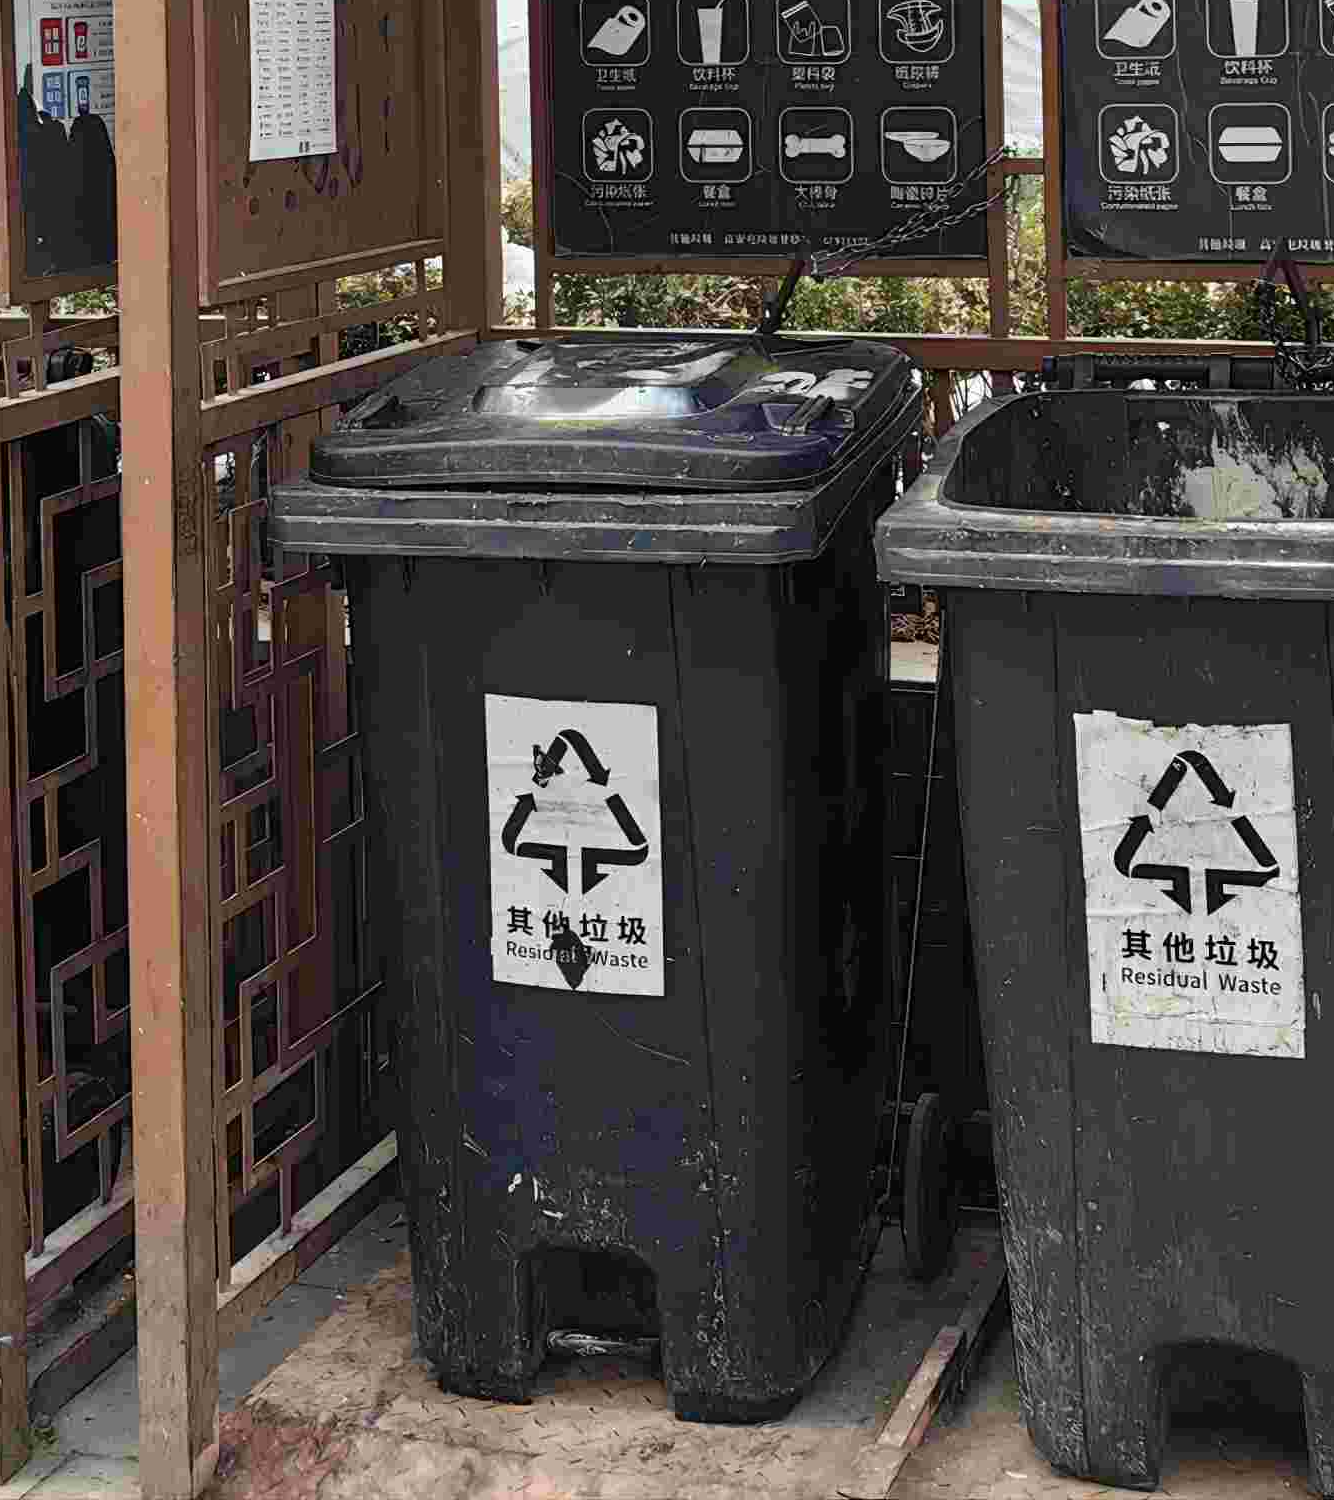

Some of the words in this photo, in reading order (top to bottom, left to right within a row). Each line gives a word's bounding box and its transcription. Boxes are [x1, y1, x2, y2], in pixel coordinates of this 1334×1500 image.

[507, 905, 648, 946] 其他垃圾
[591, 948, 650, 969] Waste
[1121, 928, 1280, 971] 其他垃圾
[1121, 967, 1208, 990] Residual
[1218, 973, 1283, 996] Waste
